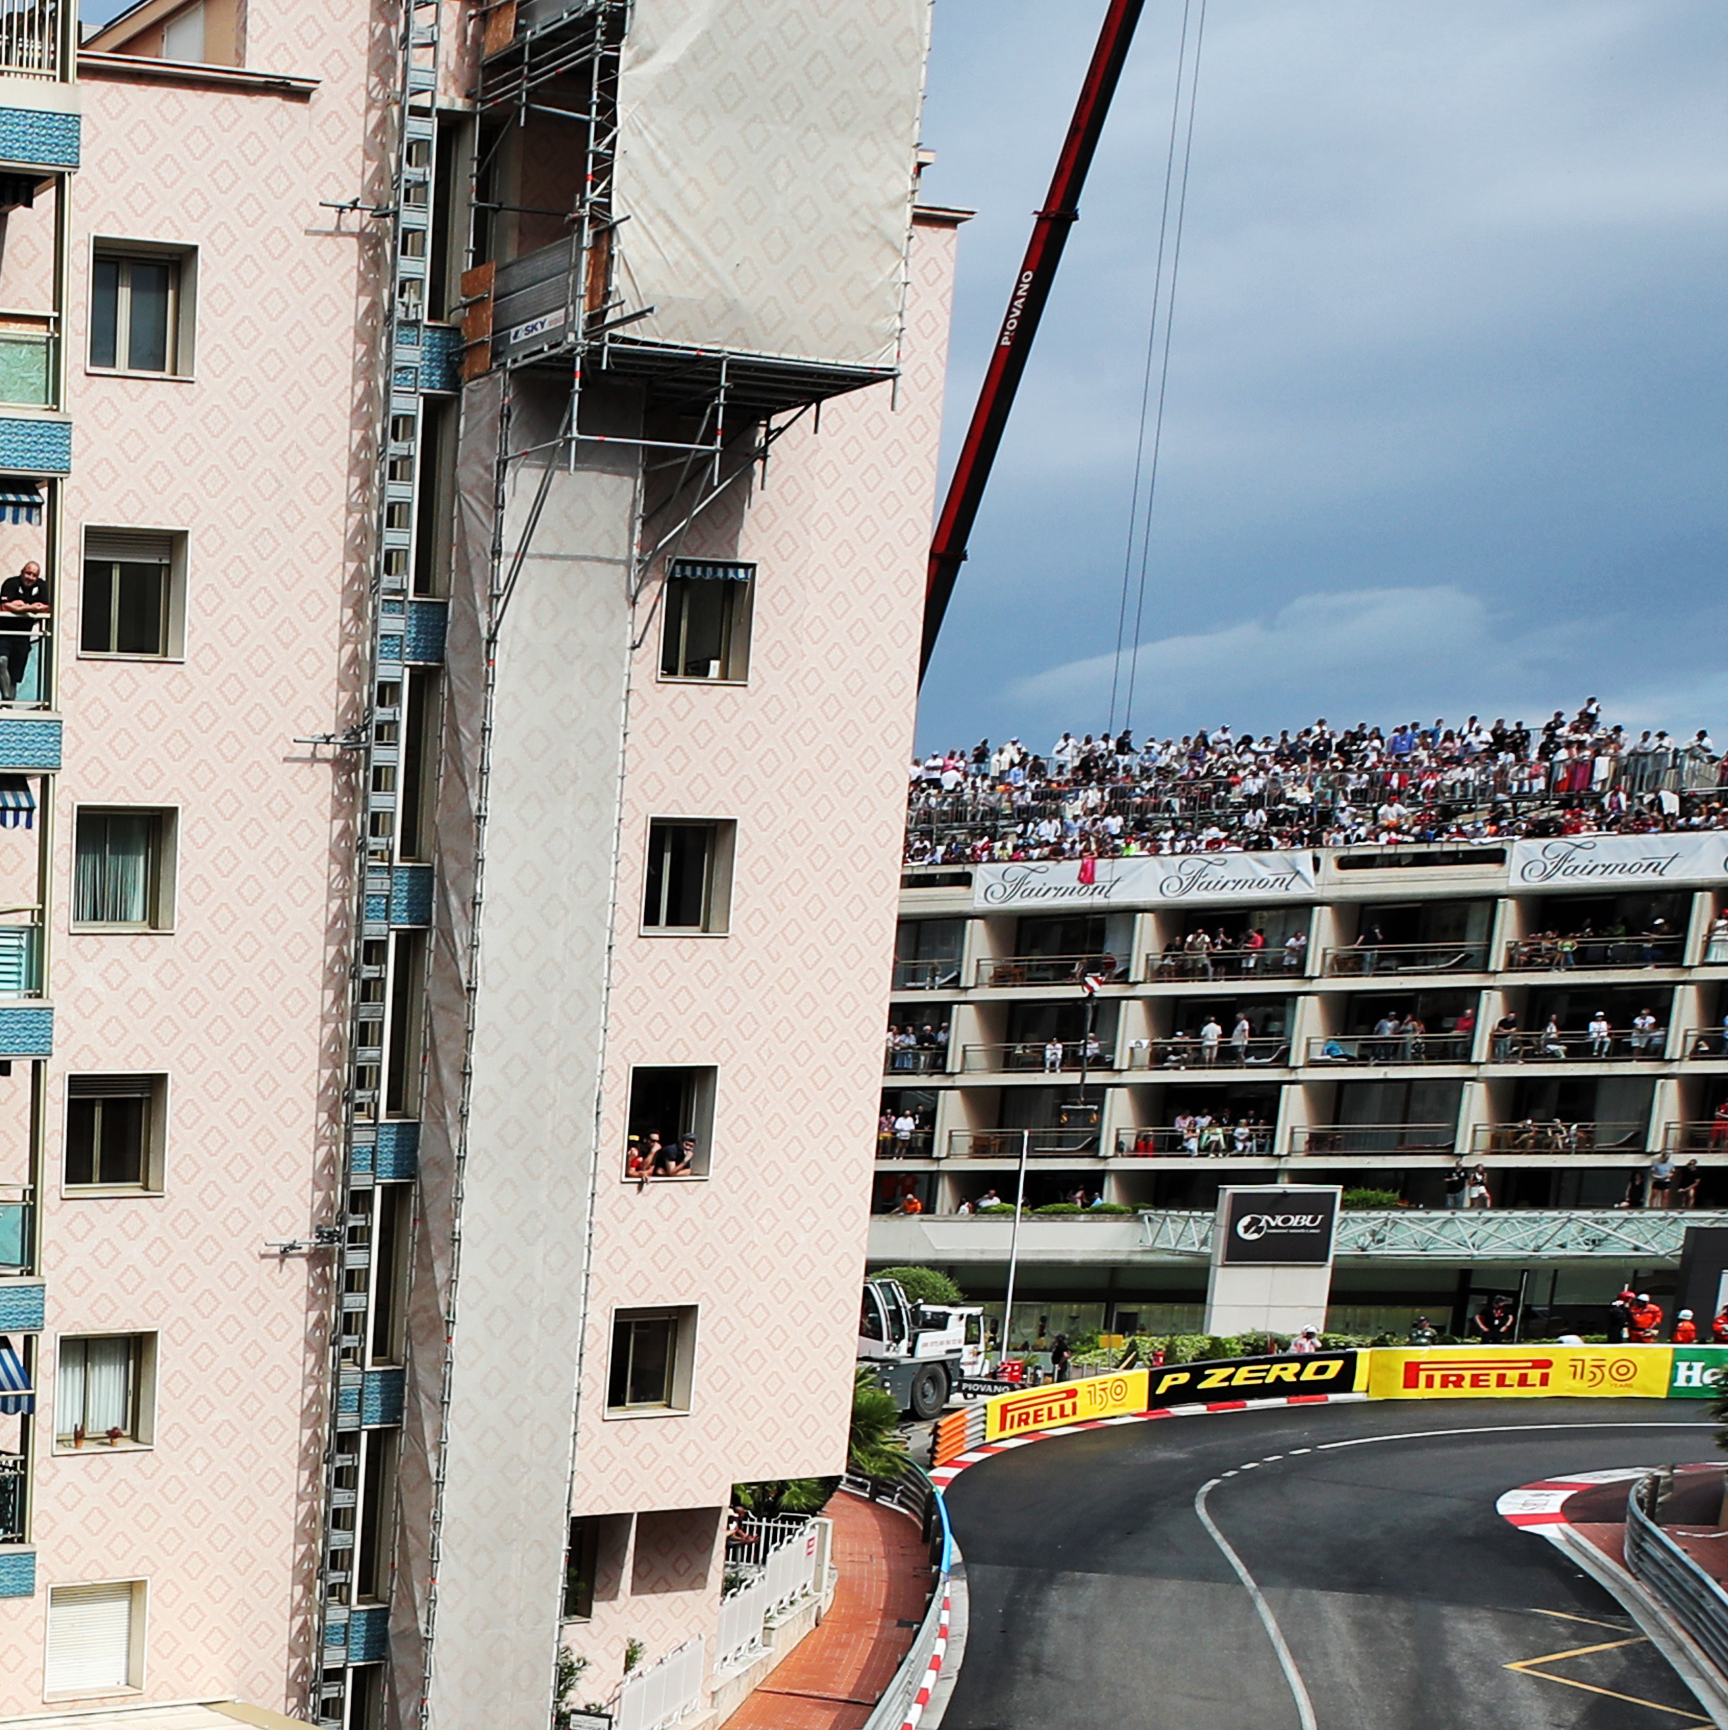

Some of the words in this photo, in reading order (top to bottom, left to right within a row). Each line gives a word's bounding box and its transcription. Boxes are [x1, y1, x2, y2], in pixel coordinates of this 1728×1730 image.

[1000, 270, 1034, 346] PIOVANO
[524, 319, 547, 336] SKY
[1159, 857, 1300, 898] Fairmont
[1521, 841, 1683, 883] Fairmont
[984, 865, 1123, 905] Fairmont
[1259, 1214, 1324, 1227] NOBU
[961, 1381, 1011, 1394] PIOVANO
[1155, 1372, 1191, 1395] P
[1196, 1359, 1345, 1390] ZERO
[1402, 1359, 1553, 1390] PIRELLI
[1569, 1358, 1637, 1388] 150
[999, 1387, 1078, 1432] PIRELLI
[1086, 1378, 1129, 1411] 150
